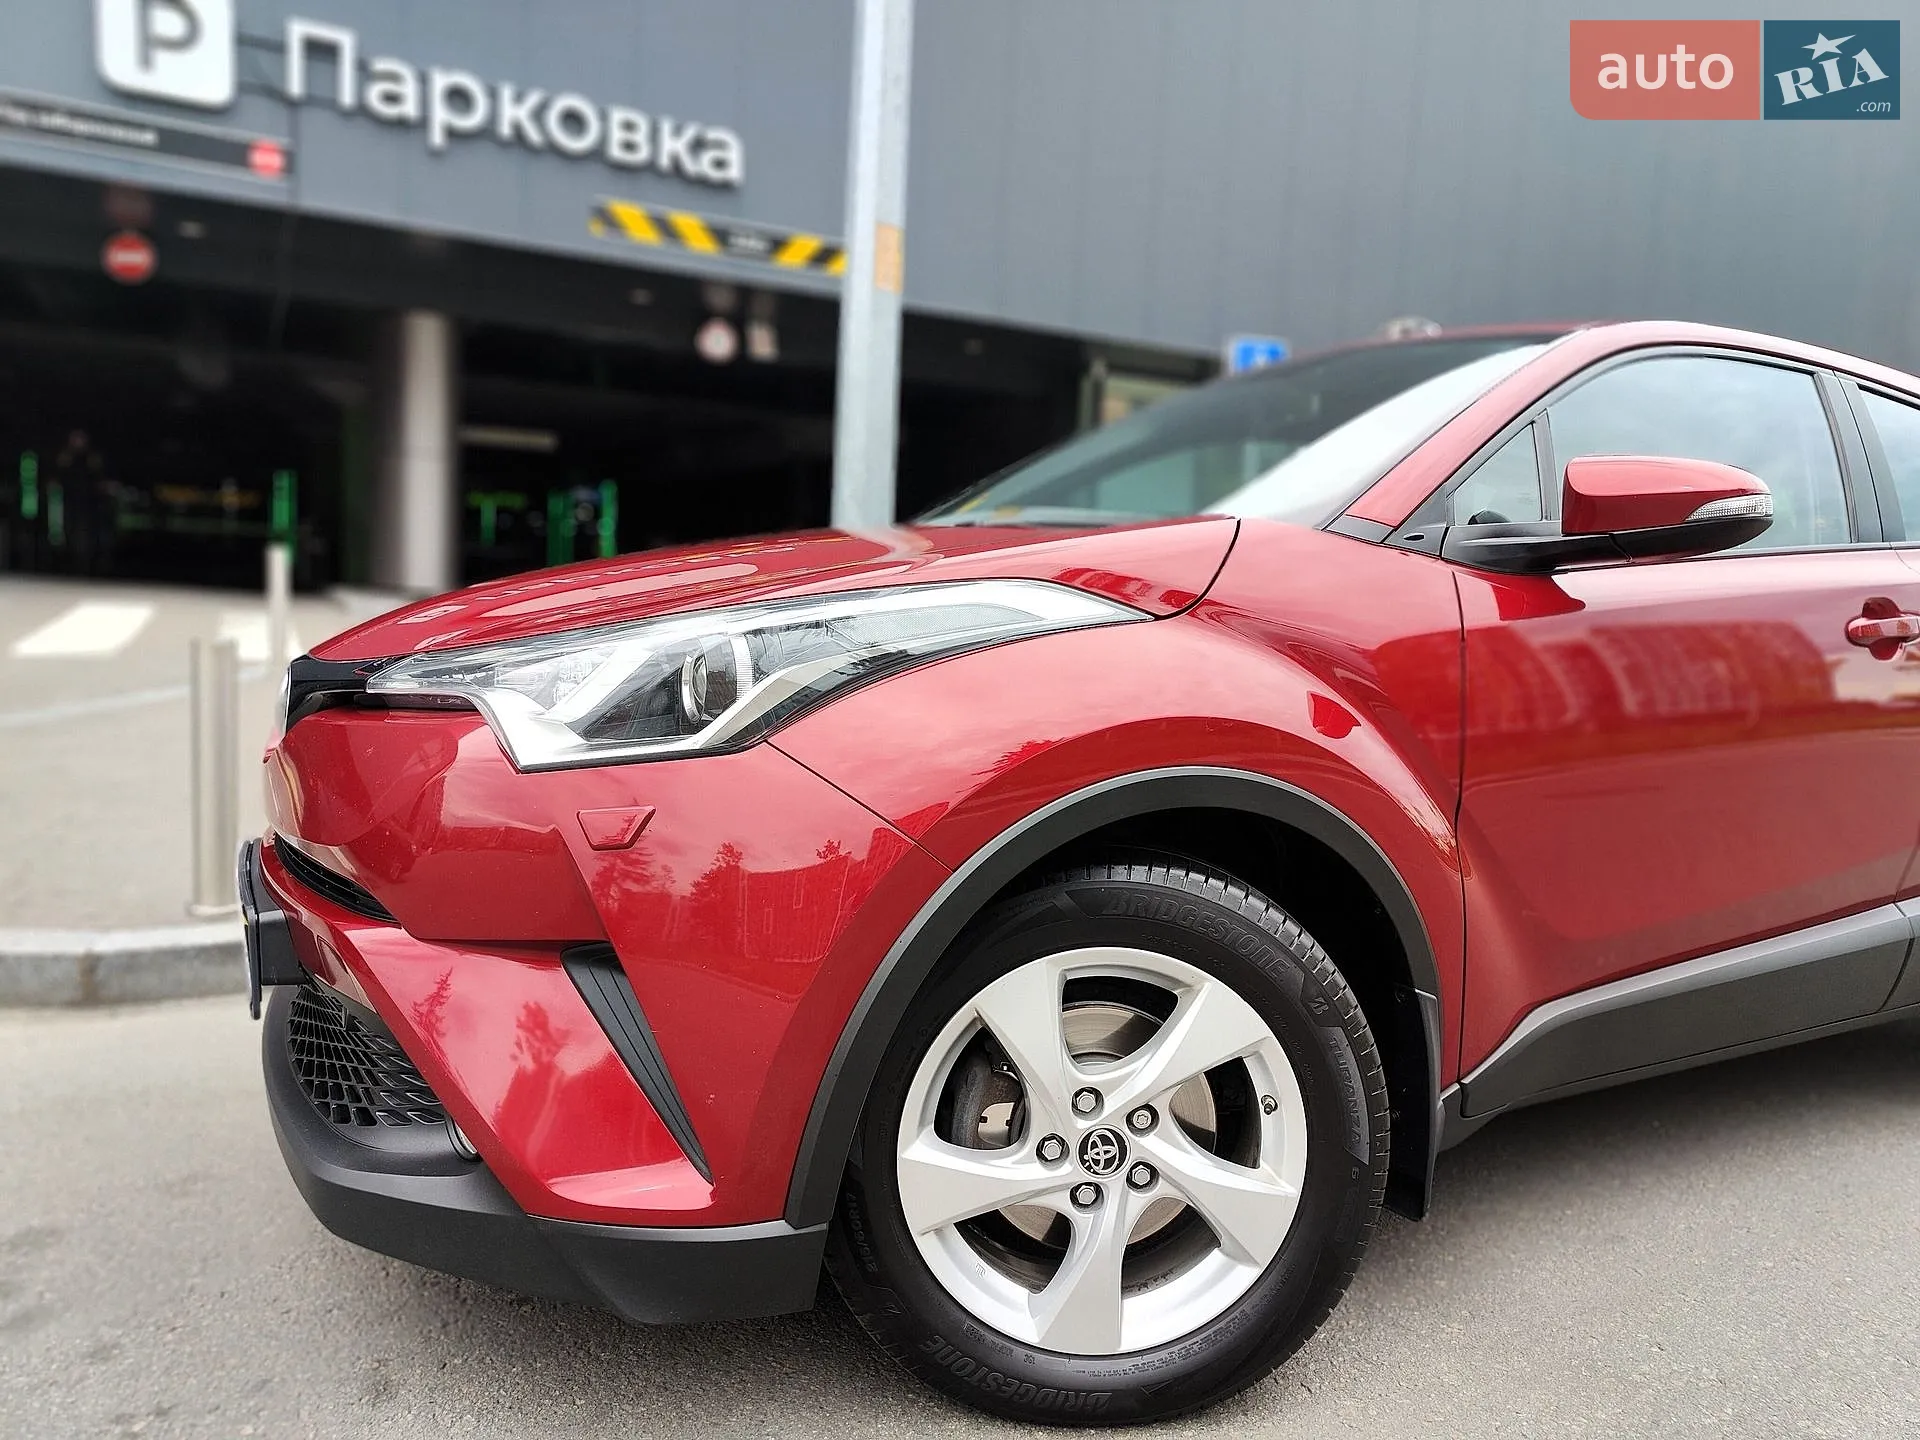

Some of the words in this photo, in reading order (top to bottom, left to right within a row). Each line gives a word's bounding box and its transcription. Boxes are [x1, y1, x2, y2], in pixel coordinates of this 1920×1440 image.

[136, 0, 201, 73] P
[286, 18, 746, 185] Парковка
[1102, 890, 1290, 979] BRIDGESTONE
[1328, 1036, 1362, 1146] TURANZA
[920, 1335, 1113, 1413] BRIDGESTONE
